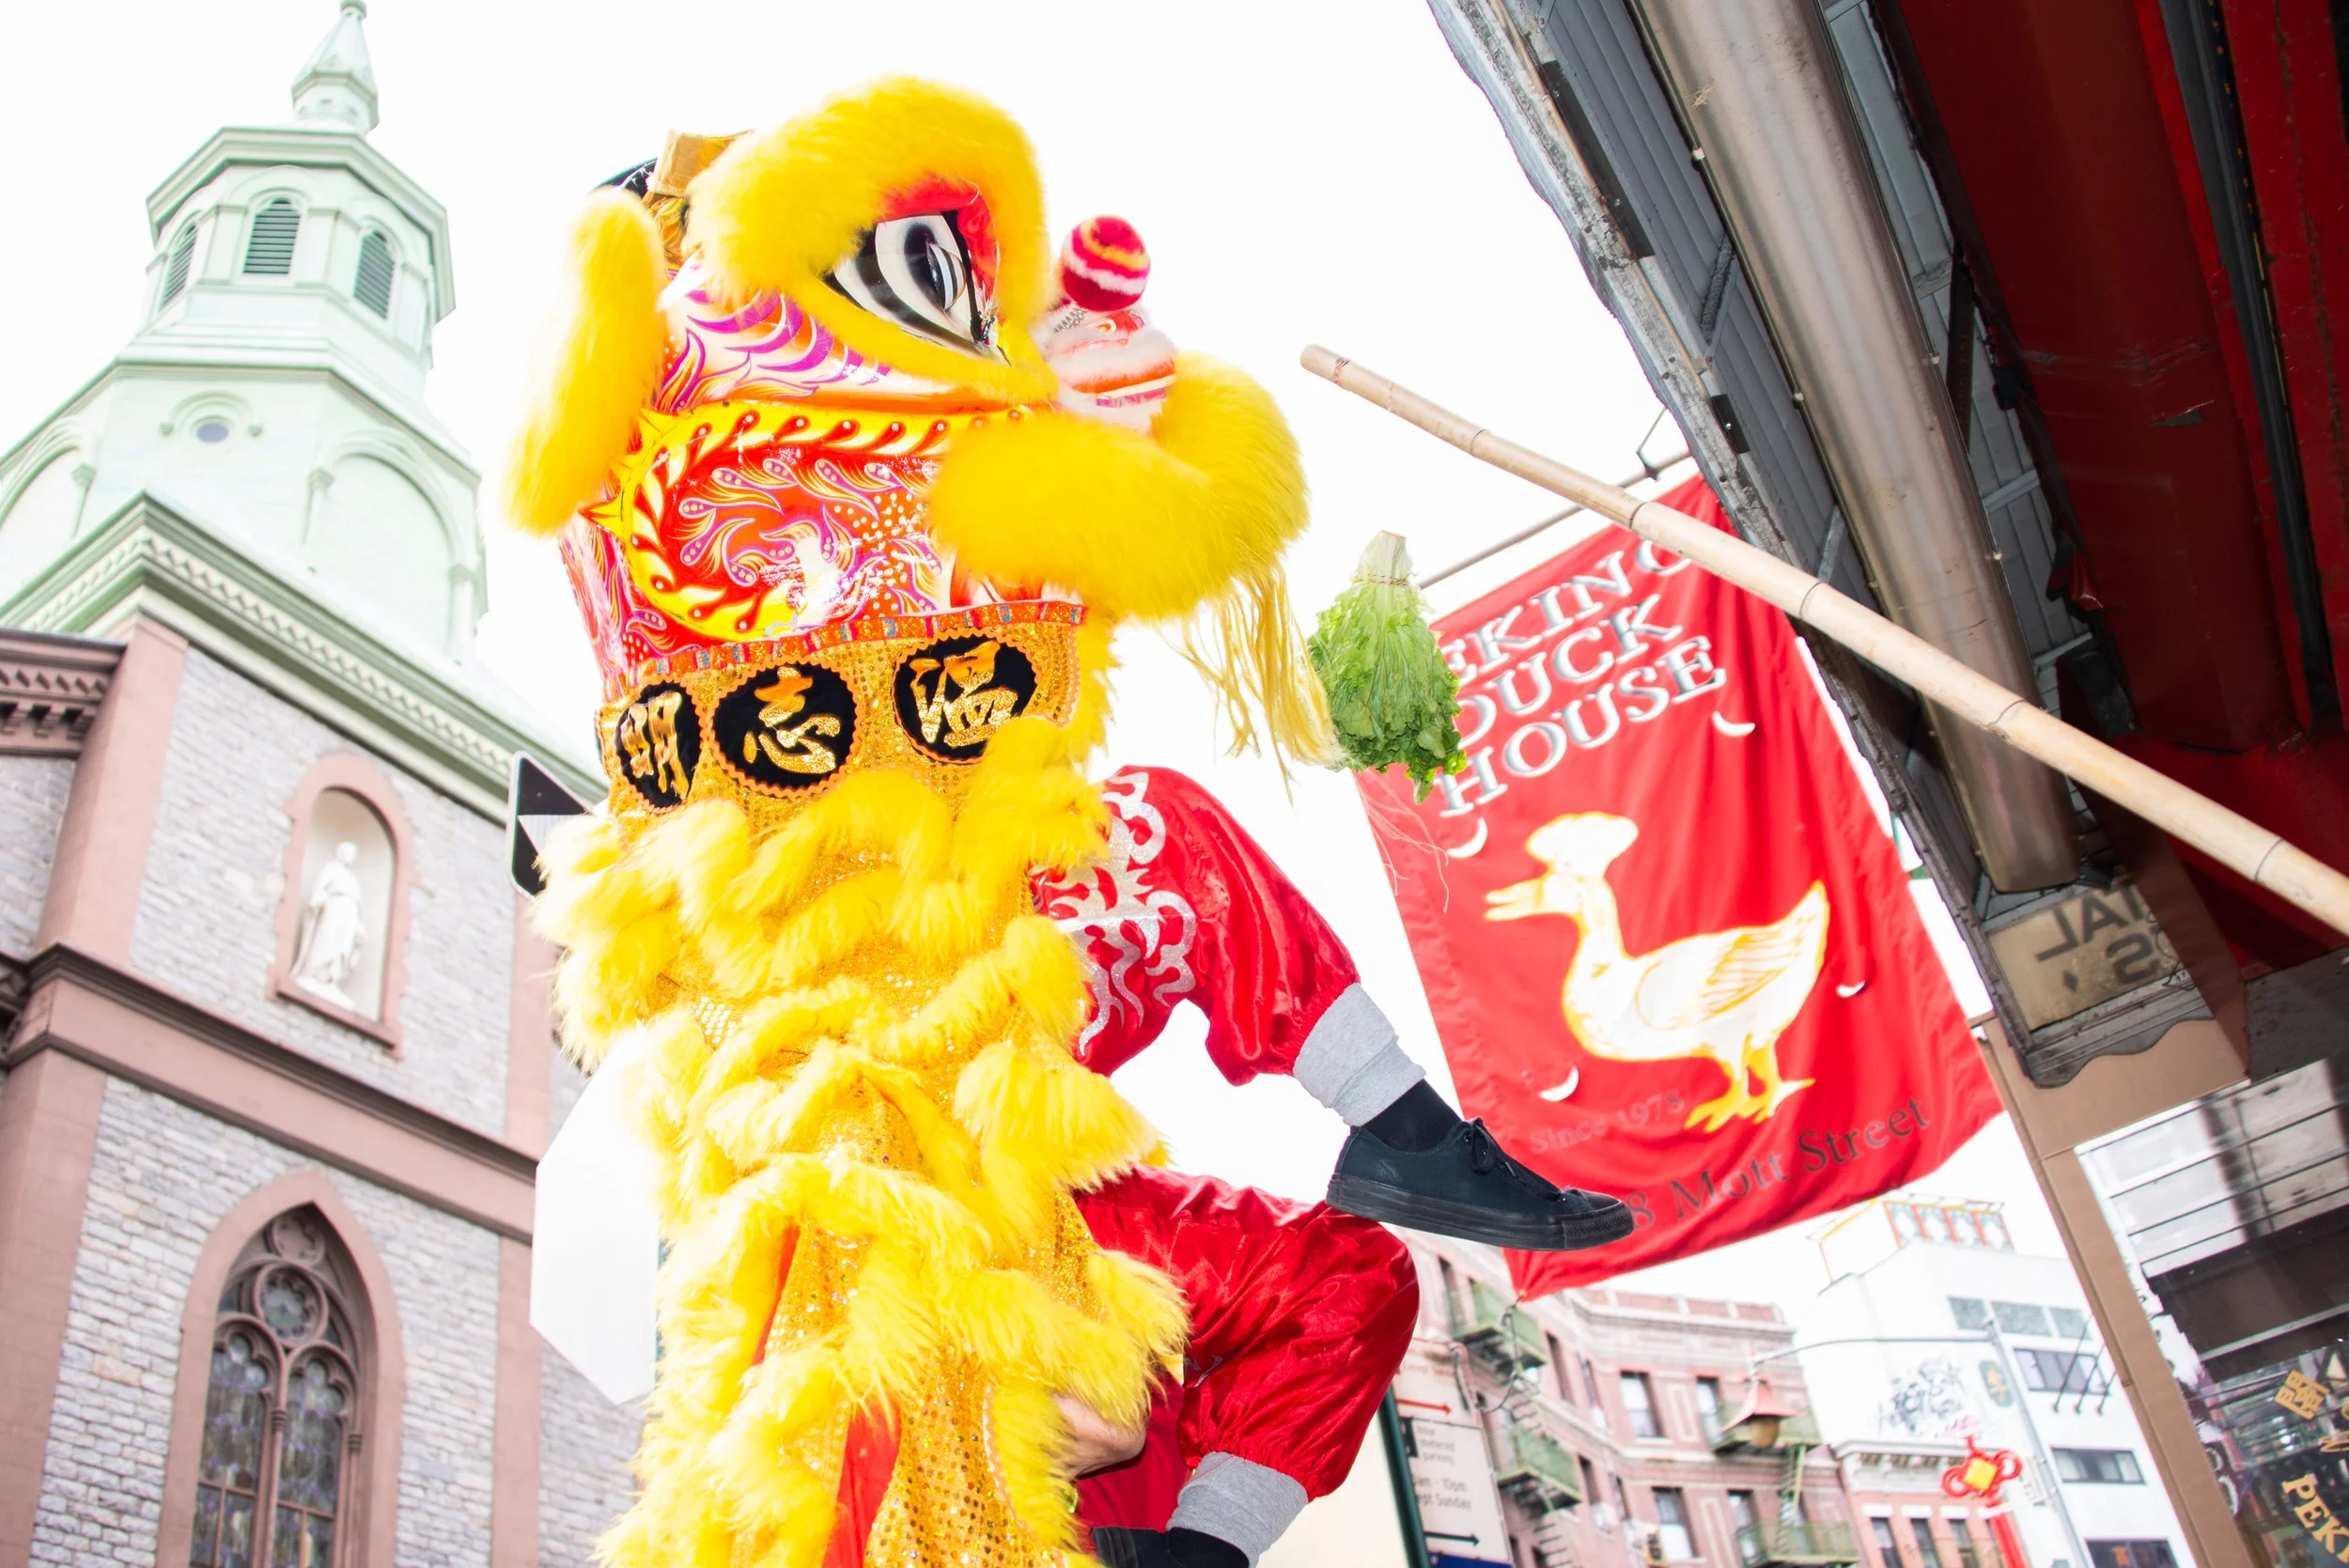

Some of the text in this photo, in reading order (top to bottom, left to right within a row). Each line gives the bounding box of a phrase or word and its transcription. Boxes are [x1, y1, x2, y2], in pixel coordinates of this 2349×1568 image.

[1440, 539, 1691, 686] EKIN
[1434, 635, 1726, 817] HOUSE
[1529, 1089, 1685, 1155] Since 1978
[1626, 1097, 1931, 1231] 8 Mott Street
